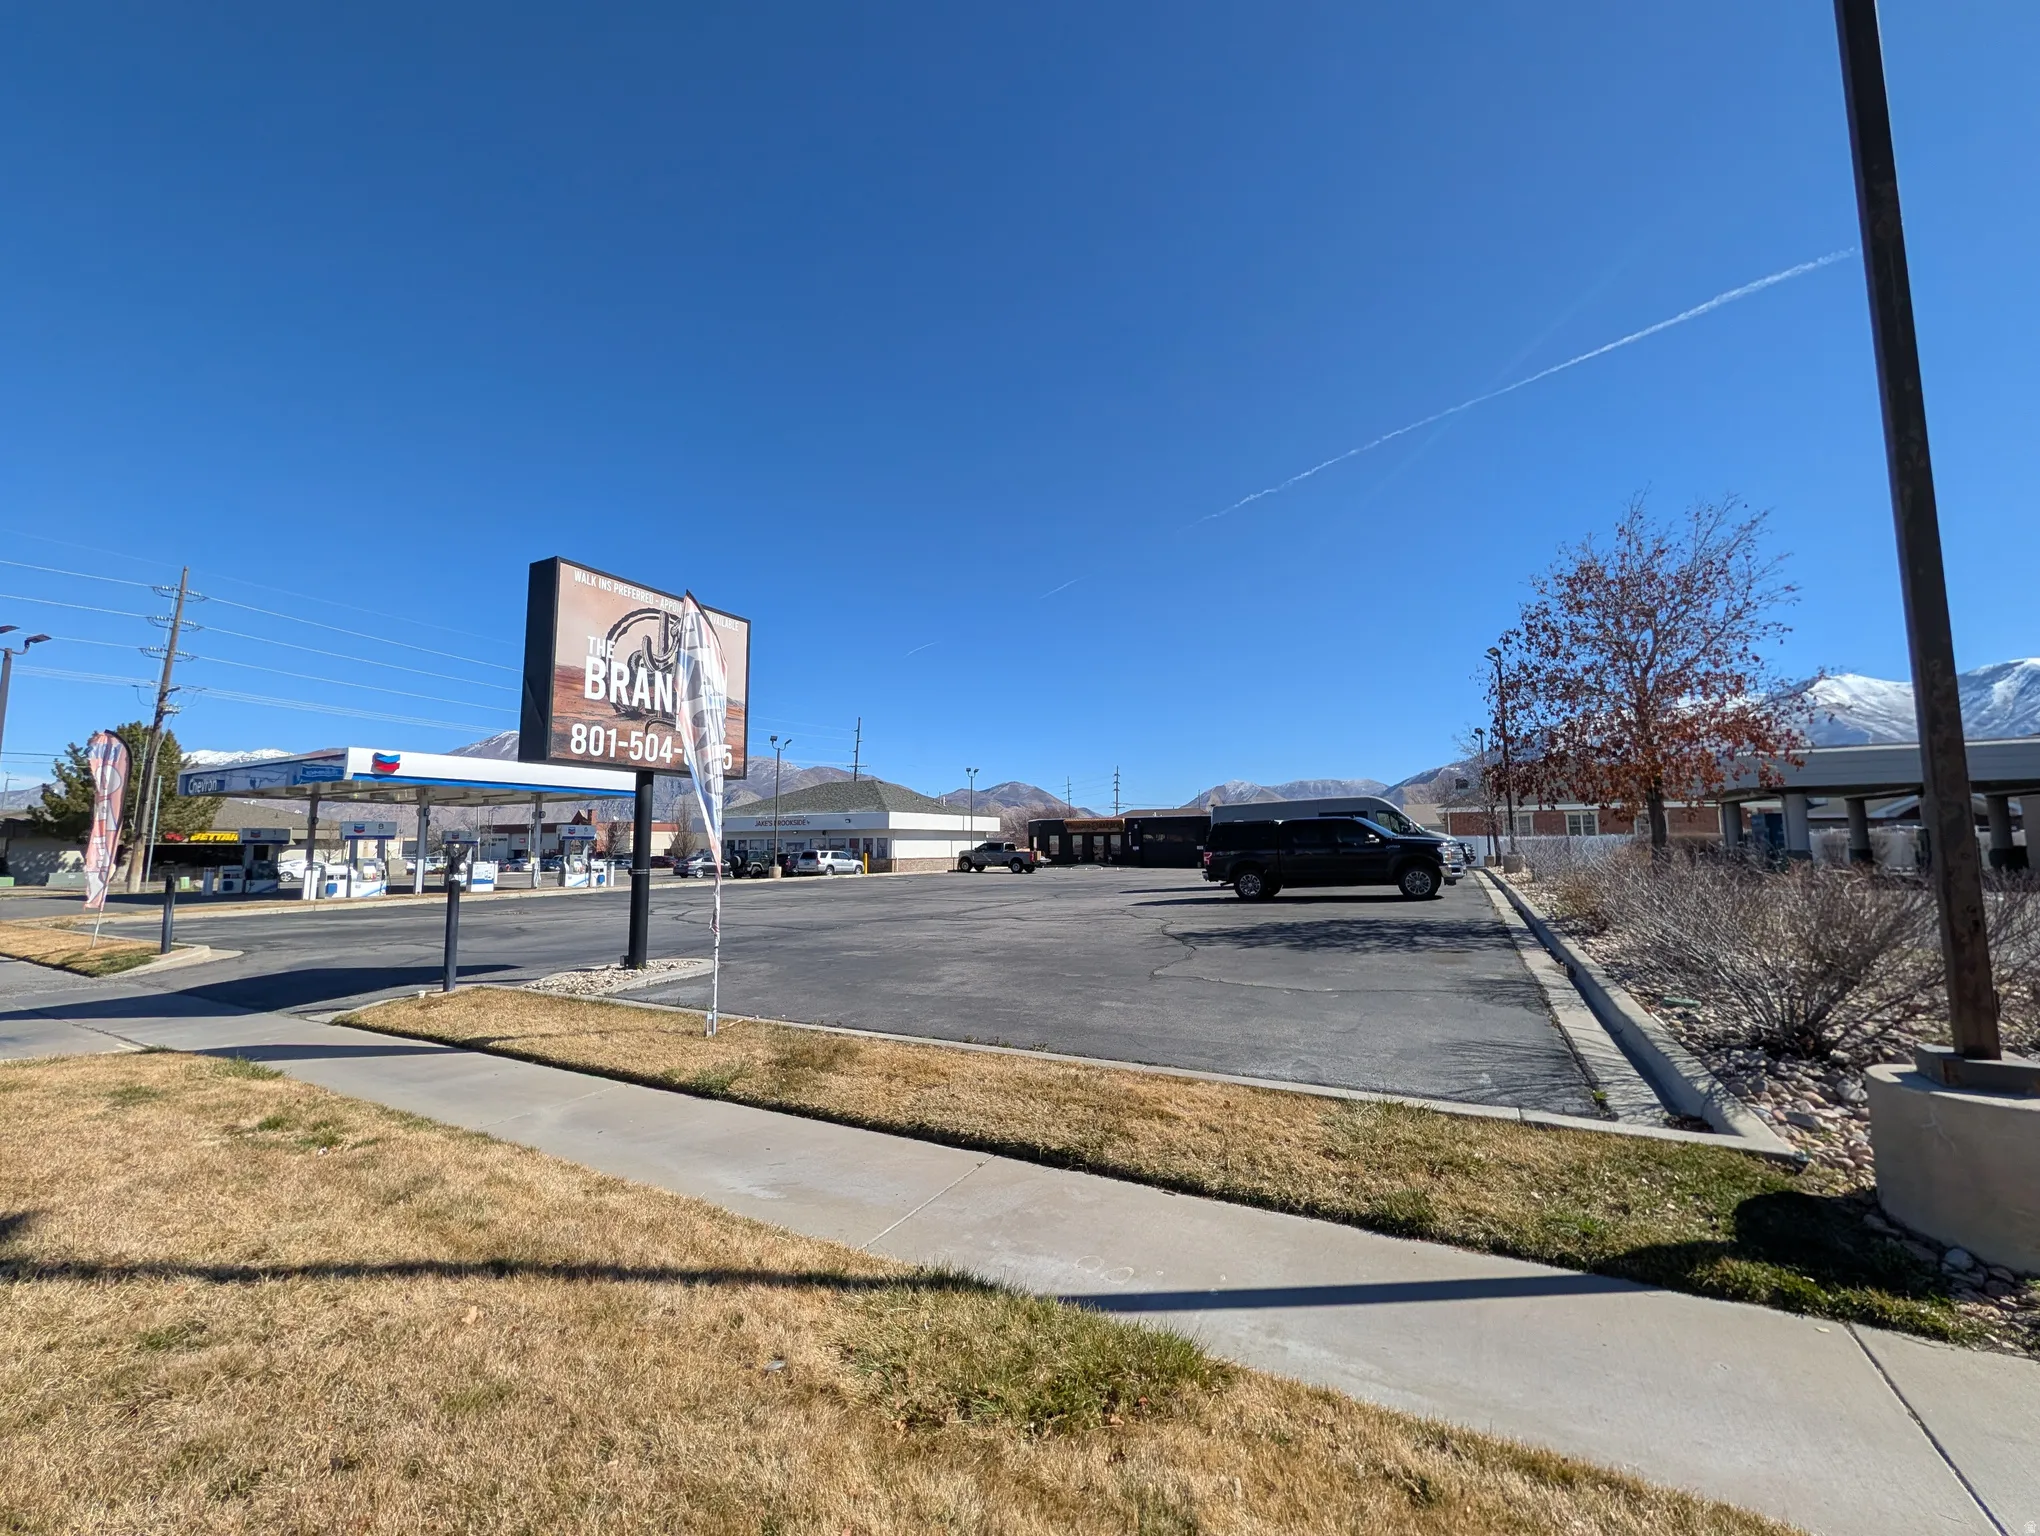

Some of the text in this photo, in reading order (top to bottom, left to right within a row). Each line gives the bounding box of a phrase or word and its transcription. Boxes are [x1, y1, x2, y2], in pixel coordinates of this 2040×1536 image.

[574, 569, 596, 587] WALK
[599, 576, 612, 592] INS
[613, 582, 654, 605] PREFERRED
[588, 635, 616, 659] THE
[585, 656, 681, 714] BRAN
[570, 723, 733, 770] 801-504-5
[755, 819, 773, 827] JAKE'S
